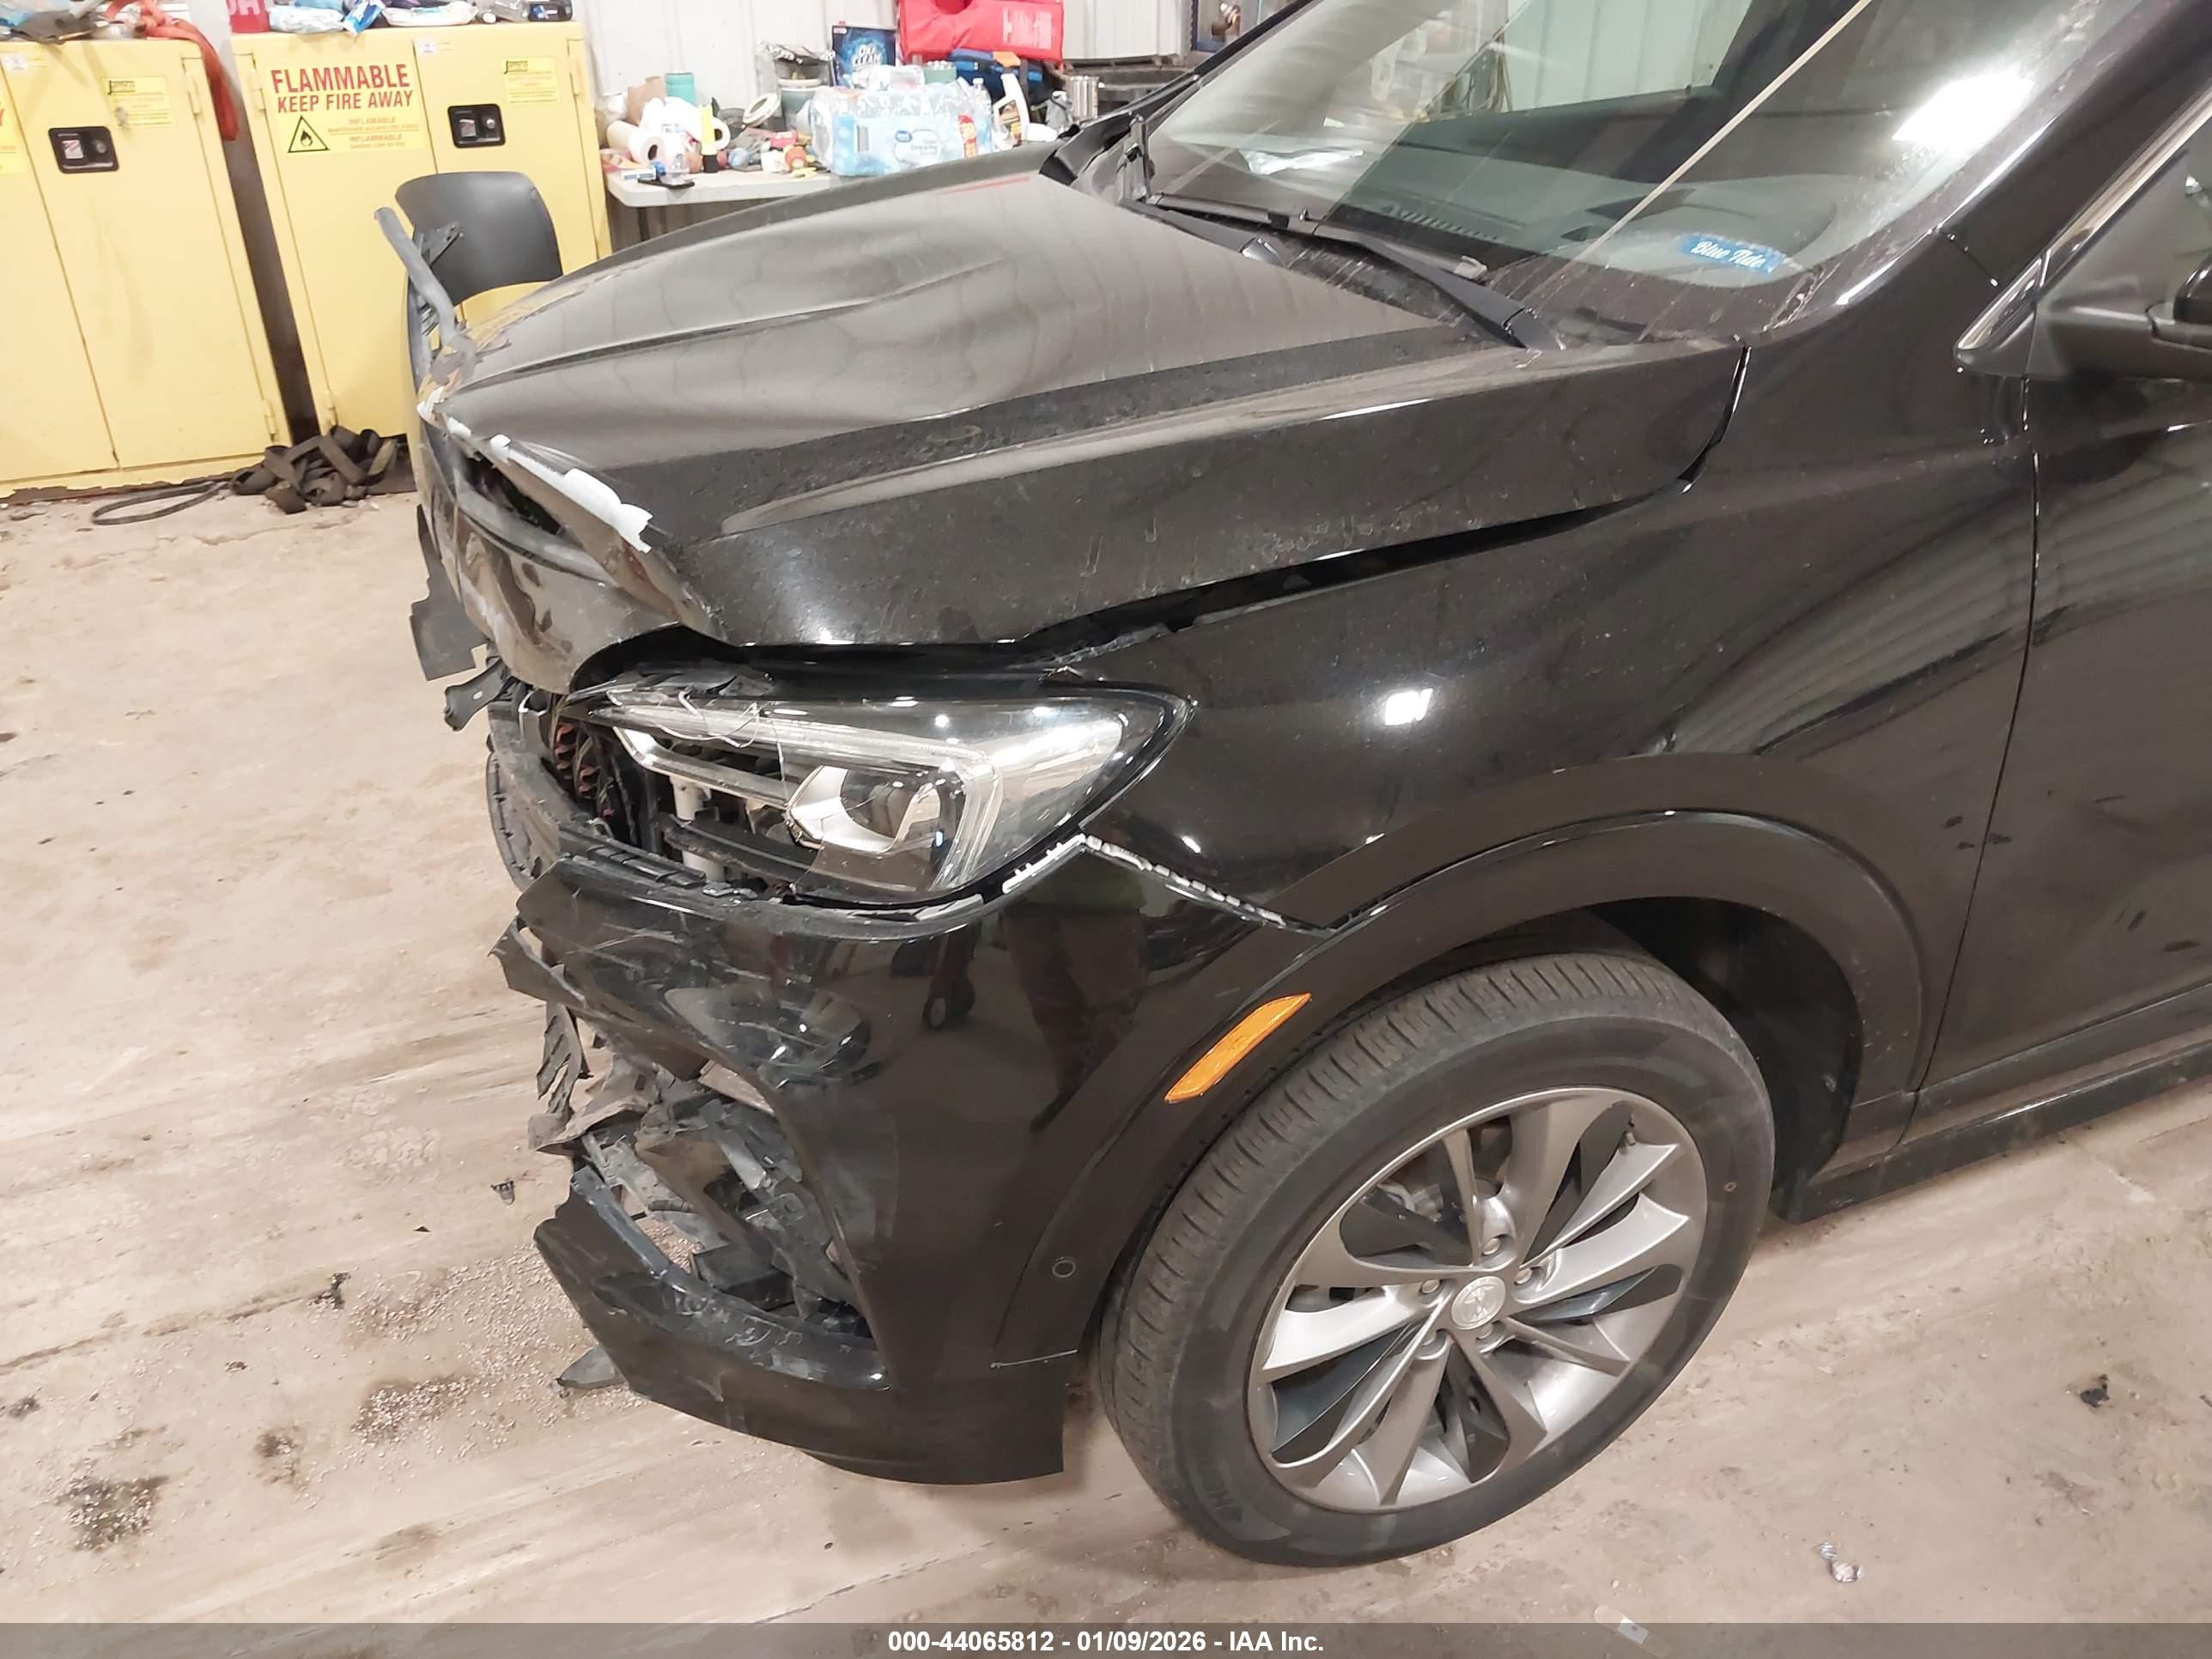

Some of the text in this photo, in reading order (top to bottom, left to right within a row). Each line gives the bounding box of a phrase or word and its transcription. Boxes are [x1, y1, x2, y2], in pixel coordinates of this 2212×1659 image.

[270, 64, 410, 94] FLAMMABLE
[277, 90, 414, 113] KEEP FIRE AWAY
[1690, 240, 1729, 258] Blue
